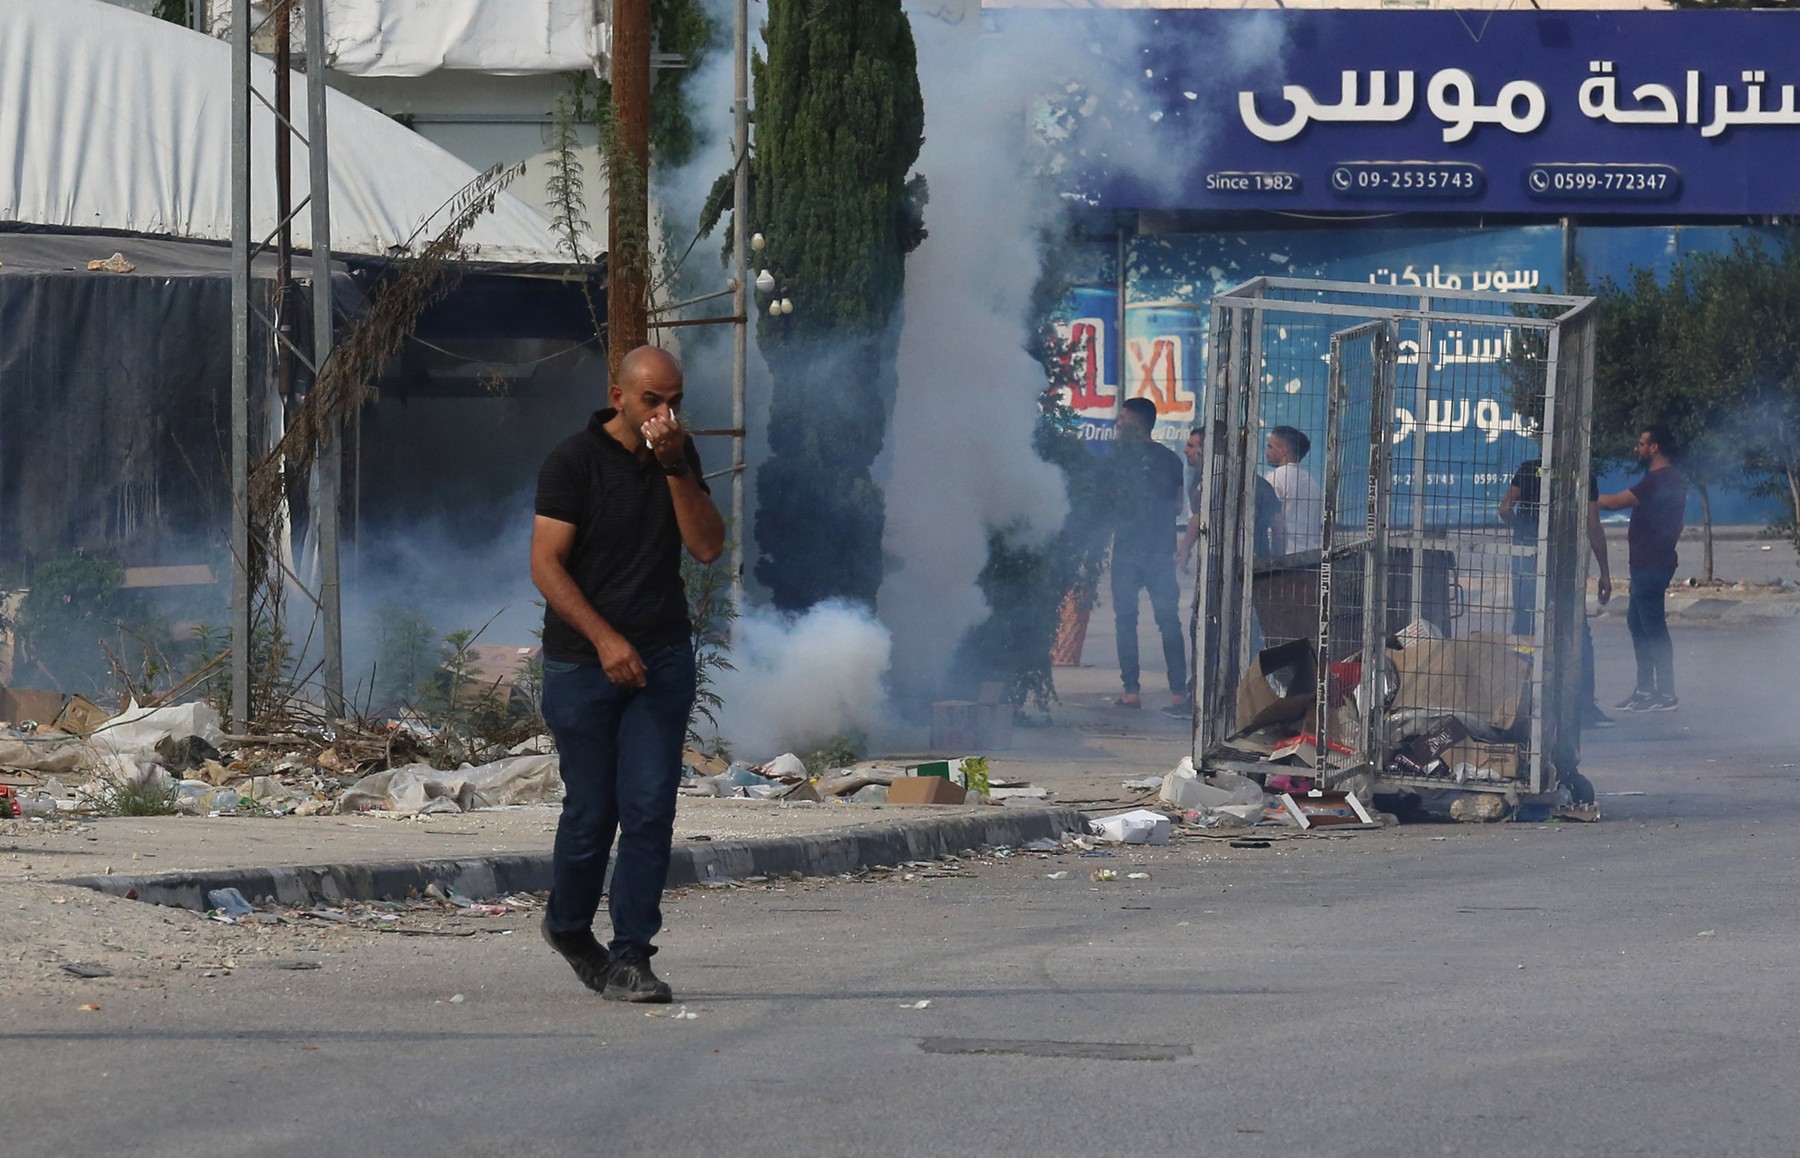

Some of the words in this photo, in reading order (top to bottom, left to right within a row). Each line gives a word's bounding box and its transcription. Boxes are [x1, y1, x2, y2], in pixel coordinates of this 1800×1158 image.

[1238, 68, 1546, 142] موسى
[1206, 174, 1249, 190] Since
[1256, 175, 1293, 190] 1982
[1358, 172, 1474, 188] 09-2535743
[1554, 173, 1667, 190] 0599-772347
[1129, 339, 1193, 414] XL
